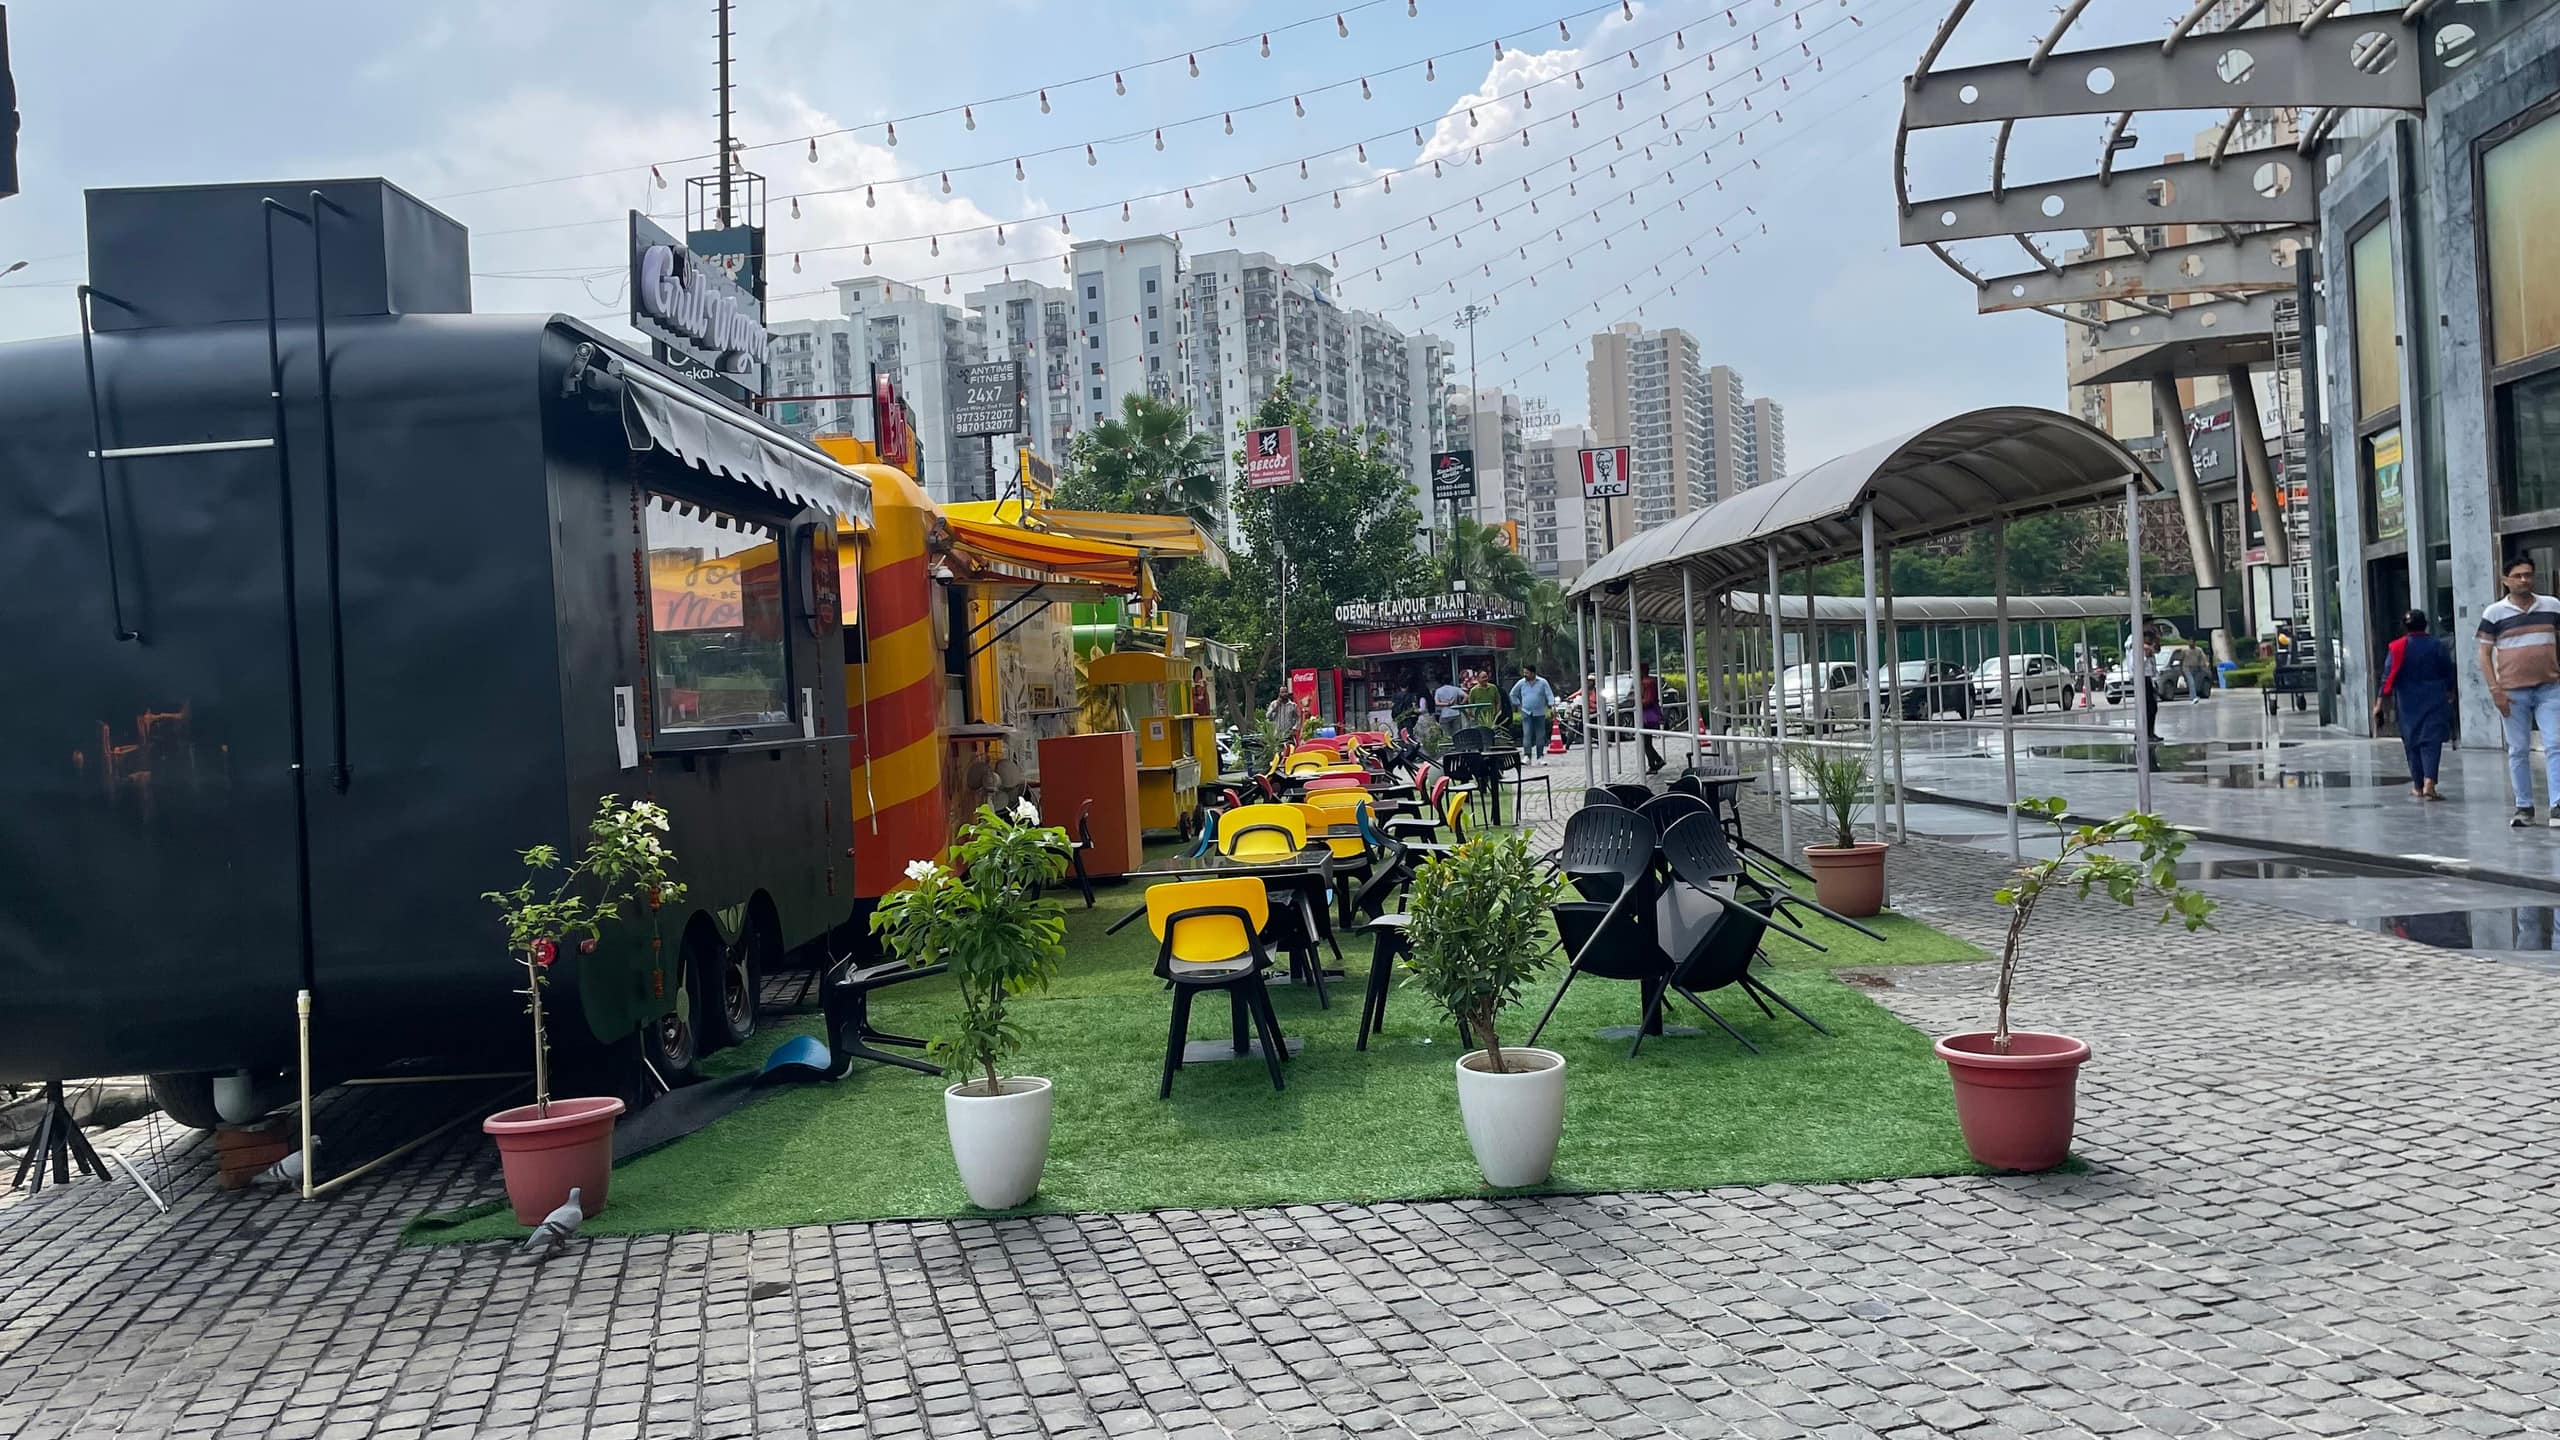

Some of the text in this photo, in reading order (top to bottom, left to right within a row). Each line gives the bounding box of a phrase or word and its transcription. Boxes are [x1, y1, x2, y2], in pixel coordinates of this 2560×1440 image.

[970, 363, 1014, 375] ANYTIME
[970, 372, 1014, 384] FITNESS
[967, 386, 1002, 404] 24x7
[956, 409, 1014, 423] 9773572077
[956, 419, 1014, 433] 9870132077
[1593, 483, 1621, 495] KFC
[1335, 604, 1371, 621] ODEON
[1378, 597, 1427, 617] FLAVOUR
[1435, 593, 1465, 610] PAAN
[1293, 672, 1315, 682] Coca-Cola
